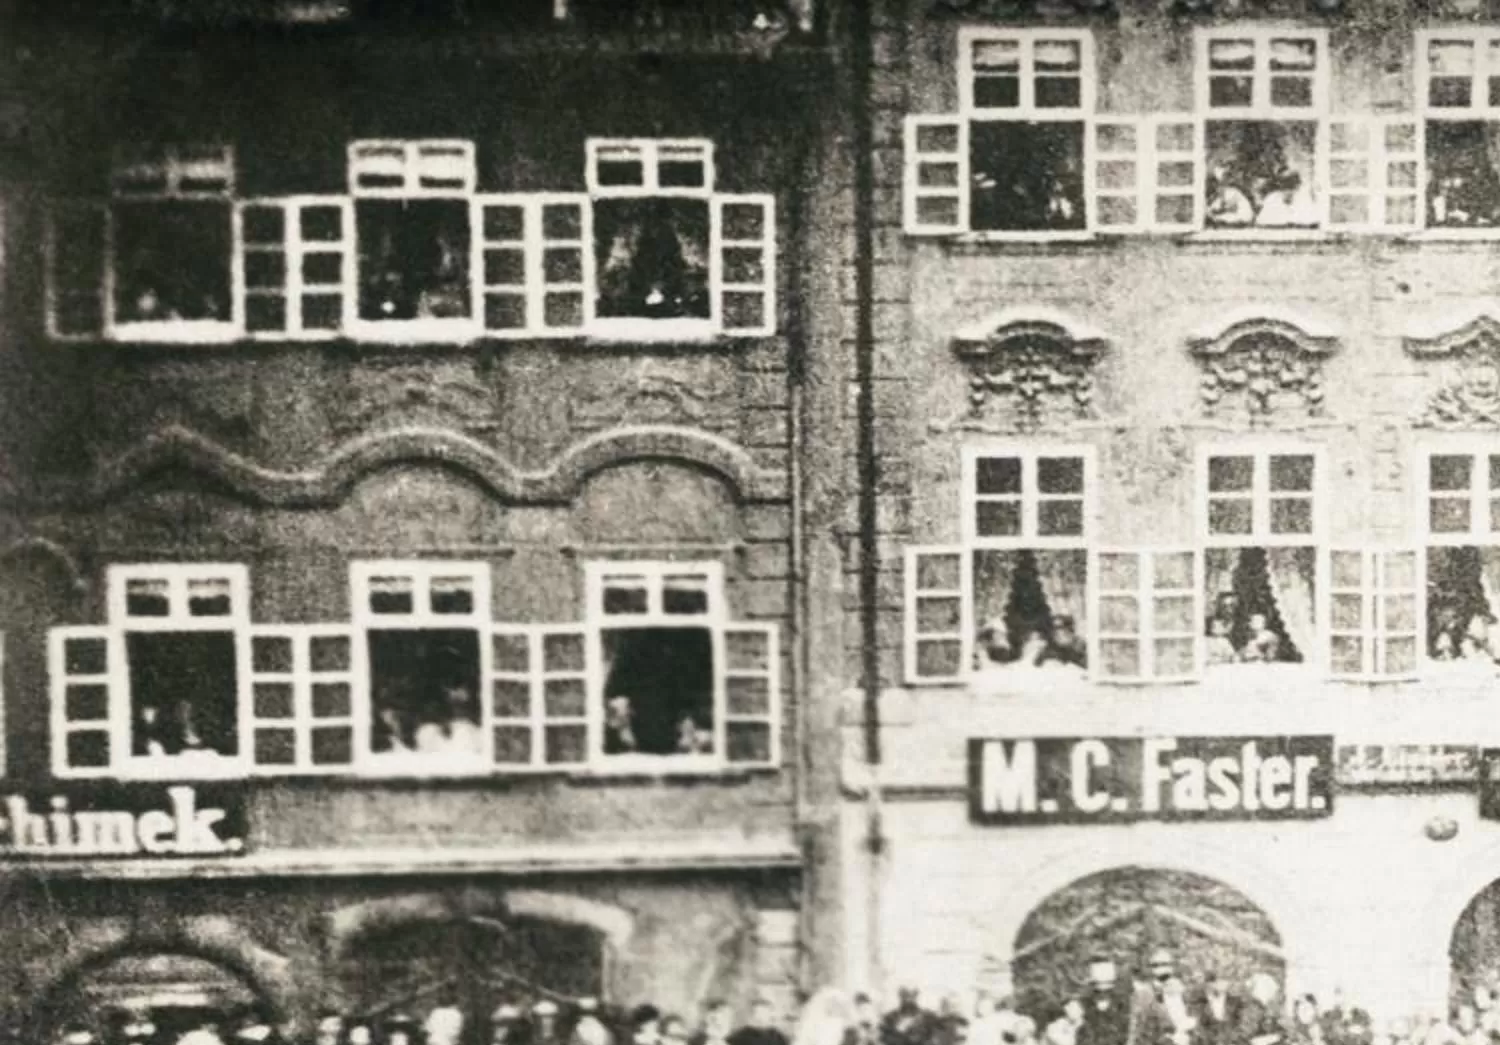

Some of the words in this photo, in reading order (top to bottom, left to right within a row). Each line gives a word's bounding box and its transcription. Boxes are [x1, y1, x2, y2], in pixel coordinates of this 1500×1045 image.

[982, 739, 1058, 812] M.
[1070, 739, 1128, 812] C.
[1142, 737, 1326, 812] Faster.
[0, 785, 243, 853] himek.
